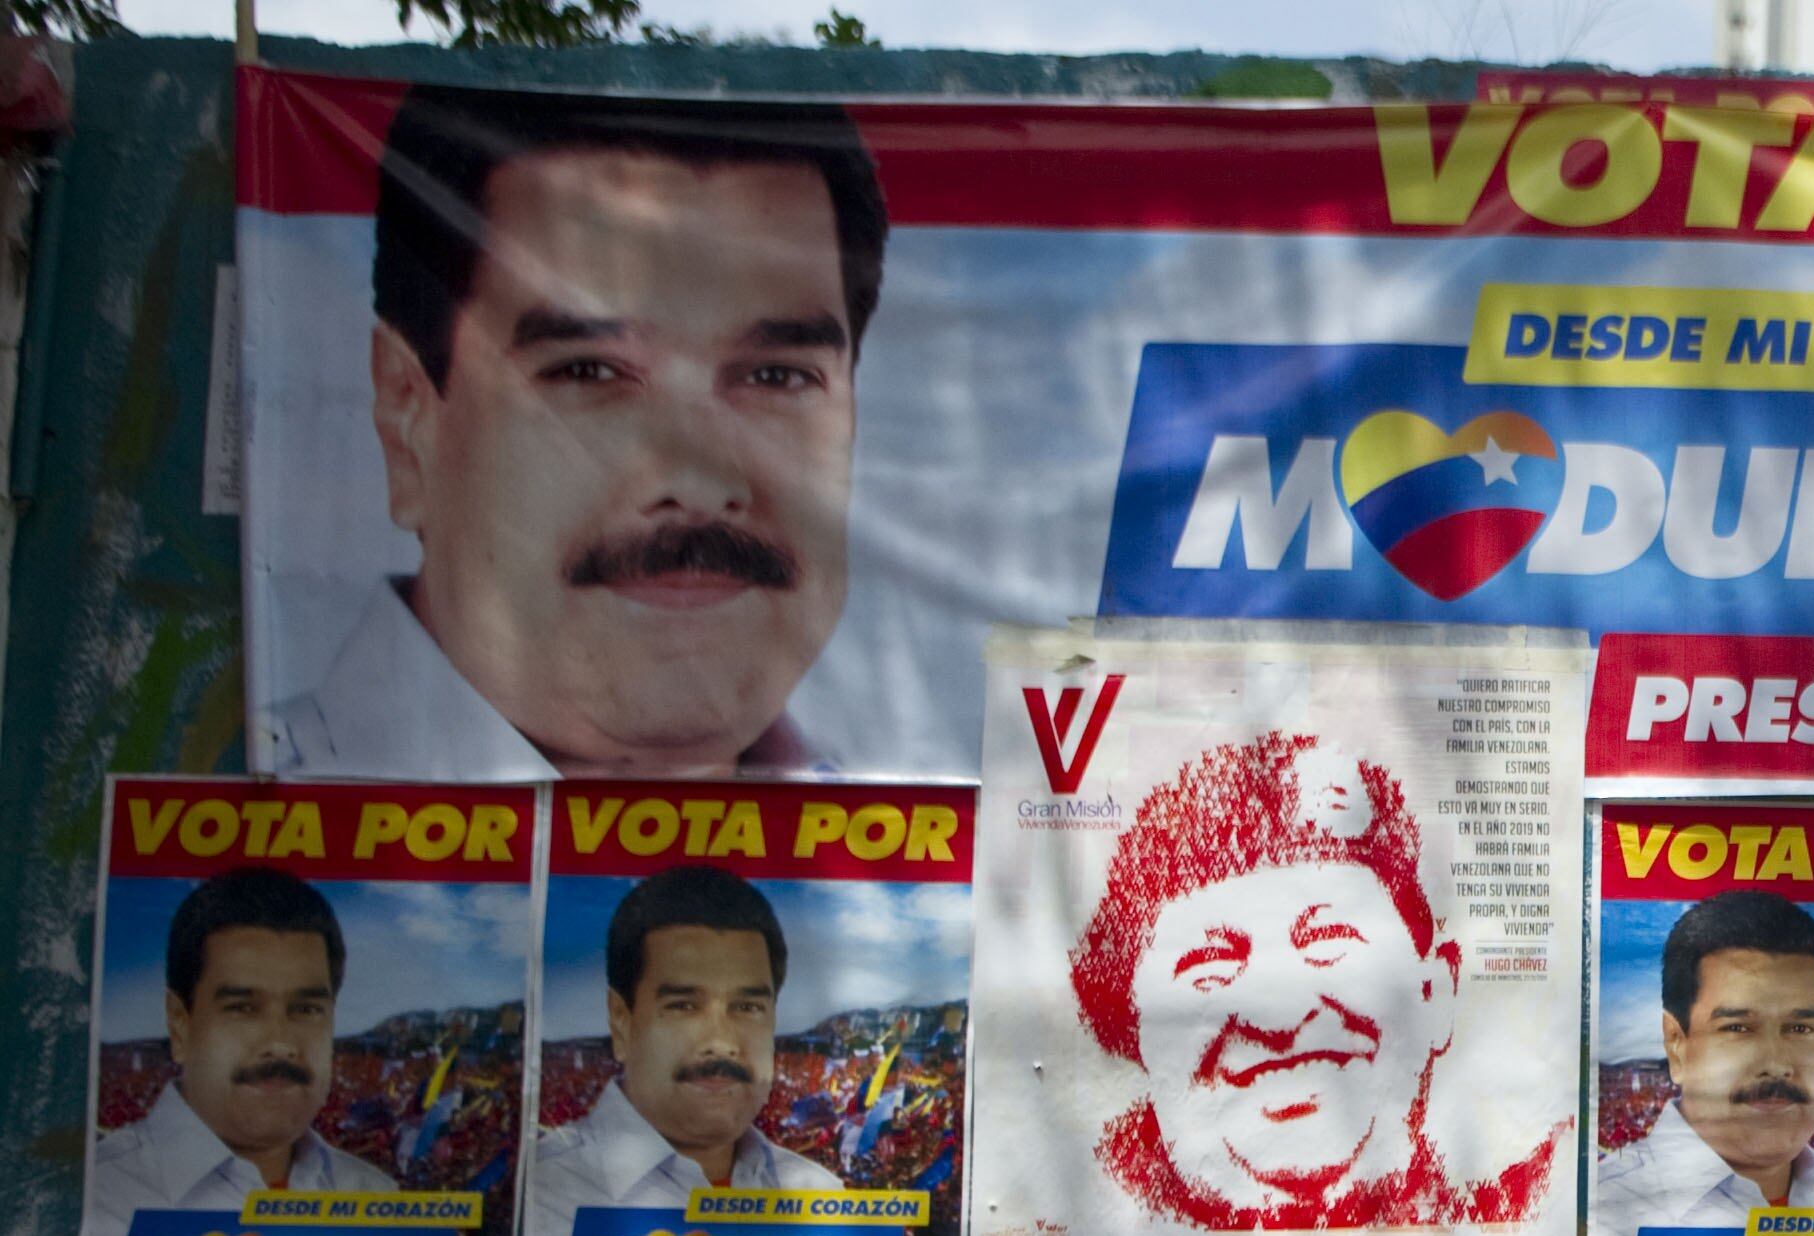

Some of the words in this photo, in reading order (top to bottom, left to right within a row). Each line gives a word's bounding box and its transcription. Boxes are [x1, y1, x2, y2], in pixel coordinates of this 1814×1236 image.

[1505, 309, 1709, 364] DESDE
[1727, 315, 1811, 367] MI
[1501, 680, 1551, 694] RATIFICAR
[1438, 699, 1482, 712] NUESTRO
[1484, 699, 1551, 714] COMPROMISO
[1453, 719, 1472, 733] CON
[1475, 720, 1486, 733] EL
[1516, 720, 1536, 734] CON
[1539, 720, 1551, 734] LA
[1446, 739, 1485, 753] FAMILIA
[1505, 761, 1551, 775] ESTAMOS
[1455, 780, 1528, 795] DEMOSTRANDO
[1531, 781, 1550, 796] QUE
[1018, 800, 1061, 818] Gran
[1066, 799, 1122, 818] Misión
[1438, 800, 1462, 815] ESTO
[1465, 801, 1478, 815] VA
[1480, 801, 1501, 815] MUY
[1504, 802, 1517, 815] EN
[129, 798, 326, 860] VOTA
[354, 802, 519, 863] POR
[568, 797, 767, 859] VOTA
[794, 802, 958, 863] POR
[1458, 822, 1471, 835] EN
[1473, 822, 1483, 835] EL
[1486, 820, 1507, 835] AÑO
[1510, 822, 1534, 836] 2019
[1536, 822, 1550, 836] NO
[1475, 841, 1509, 856] HABRÁ
[1512, 842, 1550, 856] FAMILIA
[1616, 822, 1814, 881] VOTA
[1451, 862, 1511, 877] VENEZOLANA
[1514, 863, 1533, 877] QUE
[1536, 863, 1550, 877] NO
[1456, 883, 1486, 897] TENGA
[1490, 883, 1504, 897] SU
[1505, 883, 1550, 897] VIVIENDA
[1511, 904, 1517, 918] Y
[1520, 904, 1550, 918] DIGNA
[1484, 958, 1511, 972] HUGO
[1513, 956, 1547, 972] CHÁVEZ
[254, 1200, 325, 1217] DESDE
[332, 1201, 359, 1217] MI
[365, 1196, 473, 1219] CORAZÓN
[699, 1197, 770, 1215] DESDE
[776, 1199, 804, 1216] MI
[810, 1196, 921, 1217] CORAZÓN
